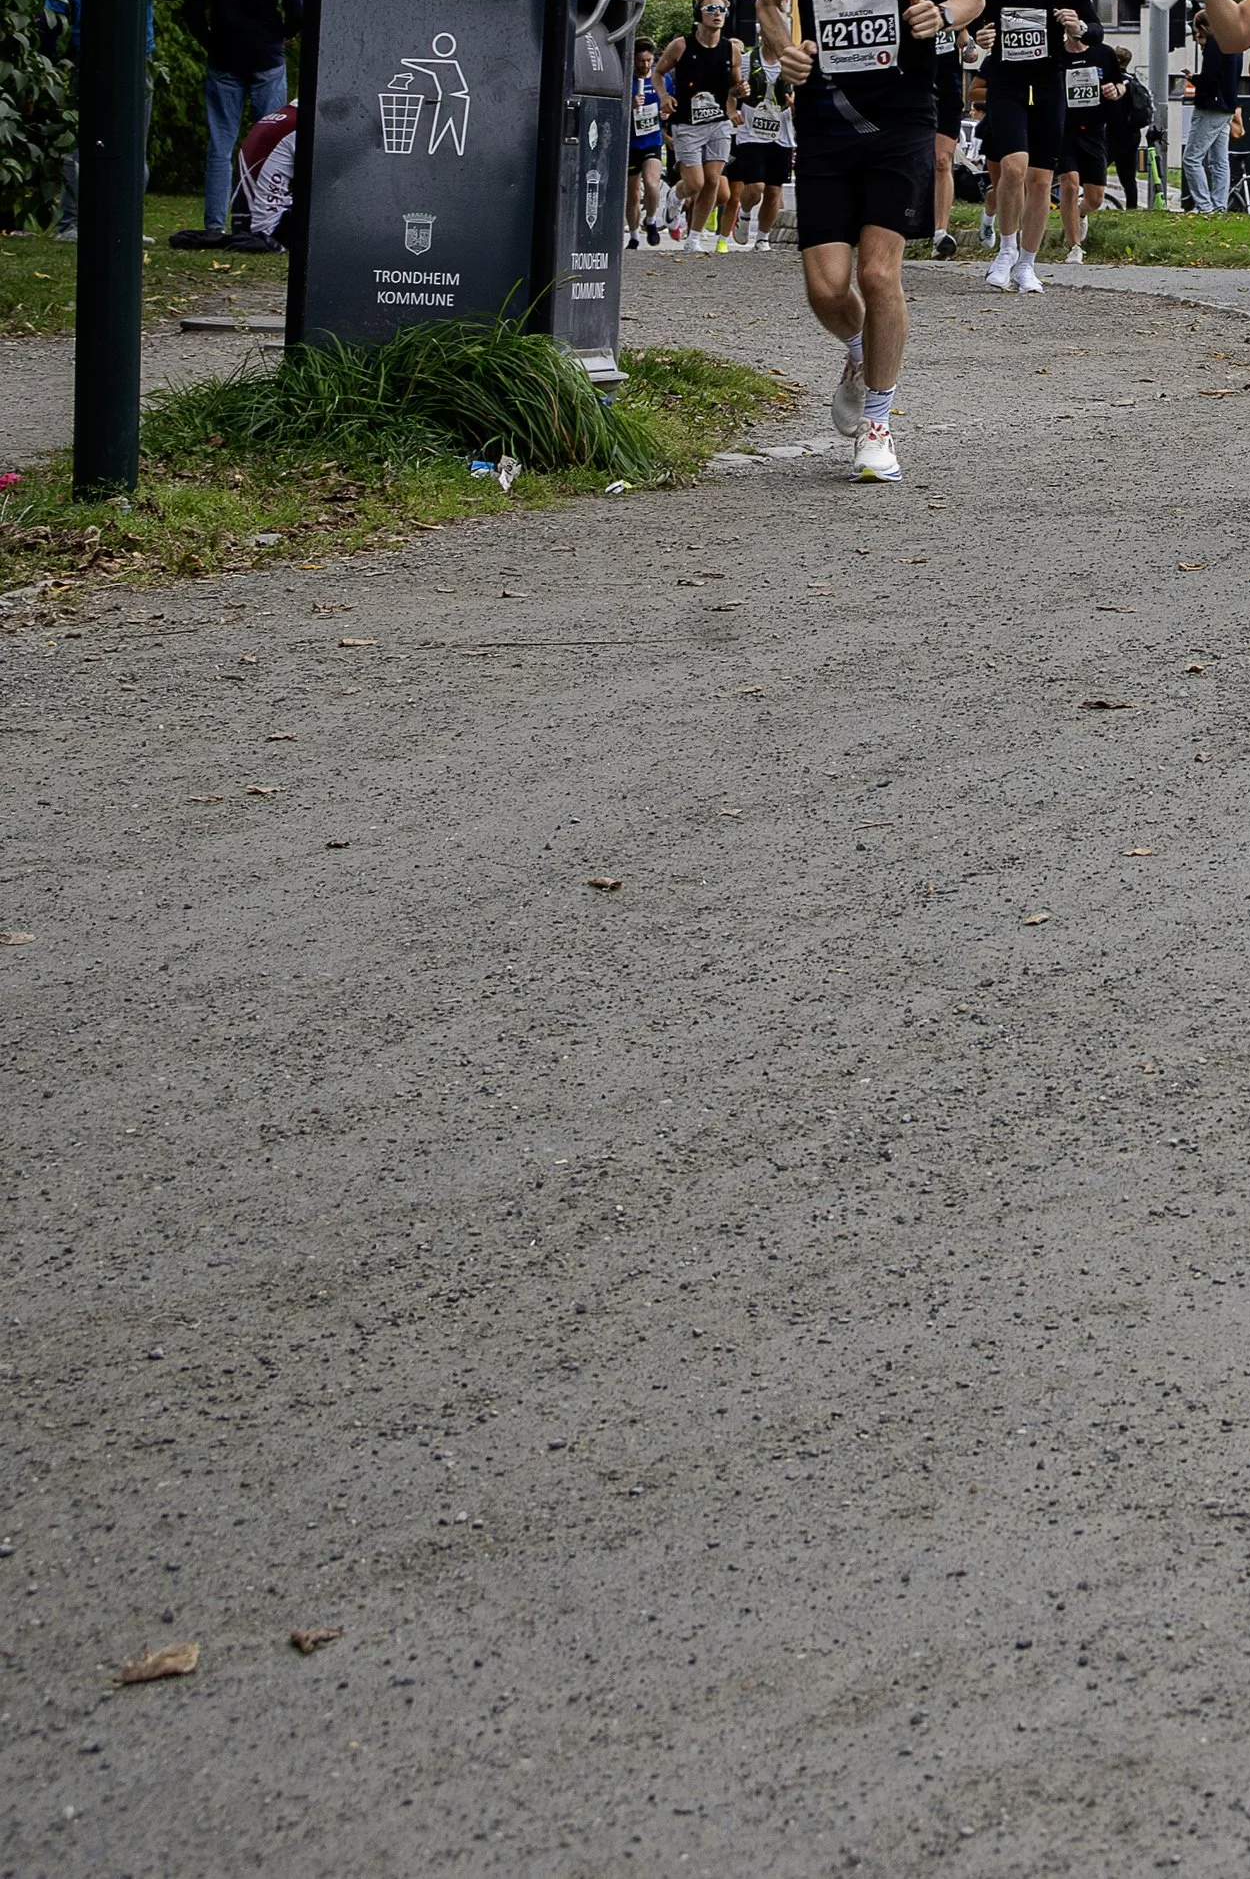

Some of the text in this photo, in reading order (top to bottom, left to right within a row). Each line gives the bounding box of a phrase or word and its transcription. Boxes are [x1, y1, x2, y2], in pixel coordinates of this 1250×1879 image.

[822, 19, 889, 48] 42182
[1004, 32, 1041, 47] 42190
[830, 52, 876, 65] SpareBank
[1073, 87, 1094, 99] 273
[753, 118, 779, 130] 43177
[571, 252, 609, 270] TRONDHEIM
[373, 269, 460, 286] TRONDHEIM
[377, 291, 455, 307] KOMMUNE
[571, 282, 605, 300] KOMMUNE
